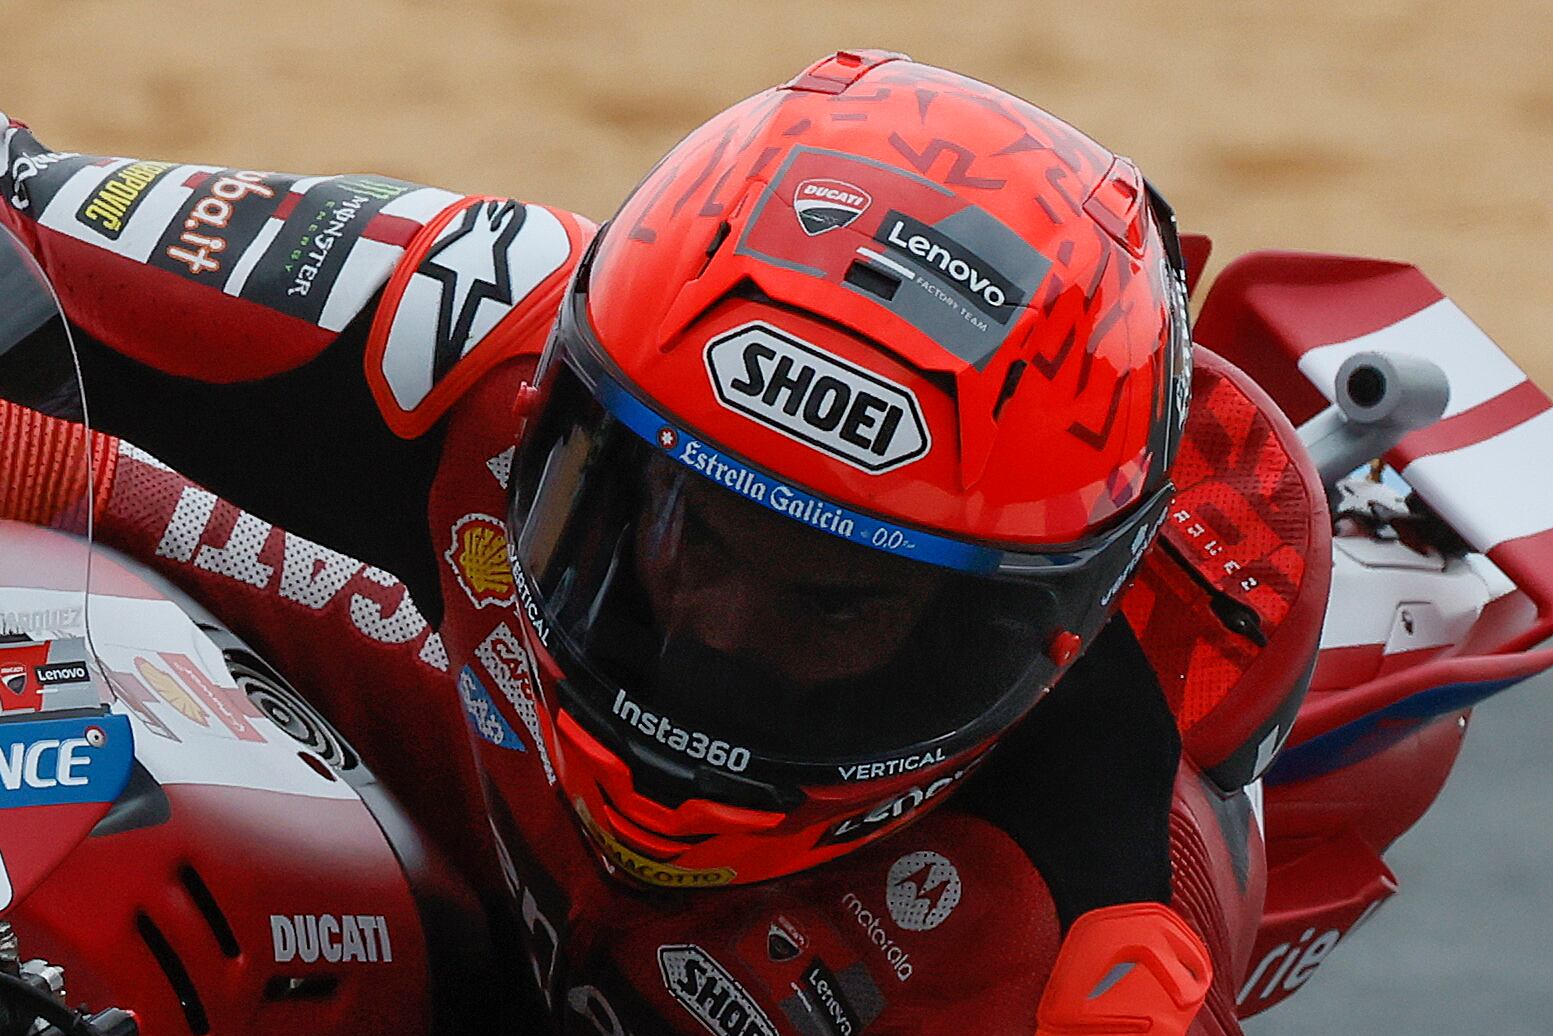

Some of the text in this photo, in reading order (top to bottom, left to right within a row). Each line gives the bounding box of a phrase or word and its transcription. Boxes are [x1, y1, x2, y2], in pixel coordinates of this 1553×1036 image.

[803, 184, 865, 207] DUCATI
[888, 221, 1006, 307] Lenovo
[916, 276, 989, 332] FACTORY TEAM
[731, 341, 904, 456] SHOEI
[678, 440, 766, 501] Estrella
[769, 485, 855, 538] Galicia
[35, 665, 86, 682] Lenovo
[611, 689, 751, 773] Insta360
[838, 748, 946, 781] VERTICAL
[270, 914, 393, 965] DUCATI
[843, 892, 914, 982] motorola
